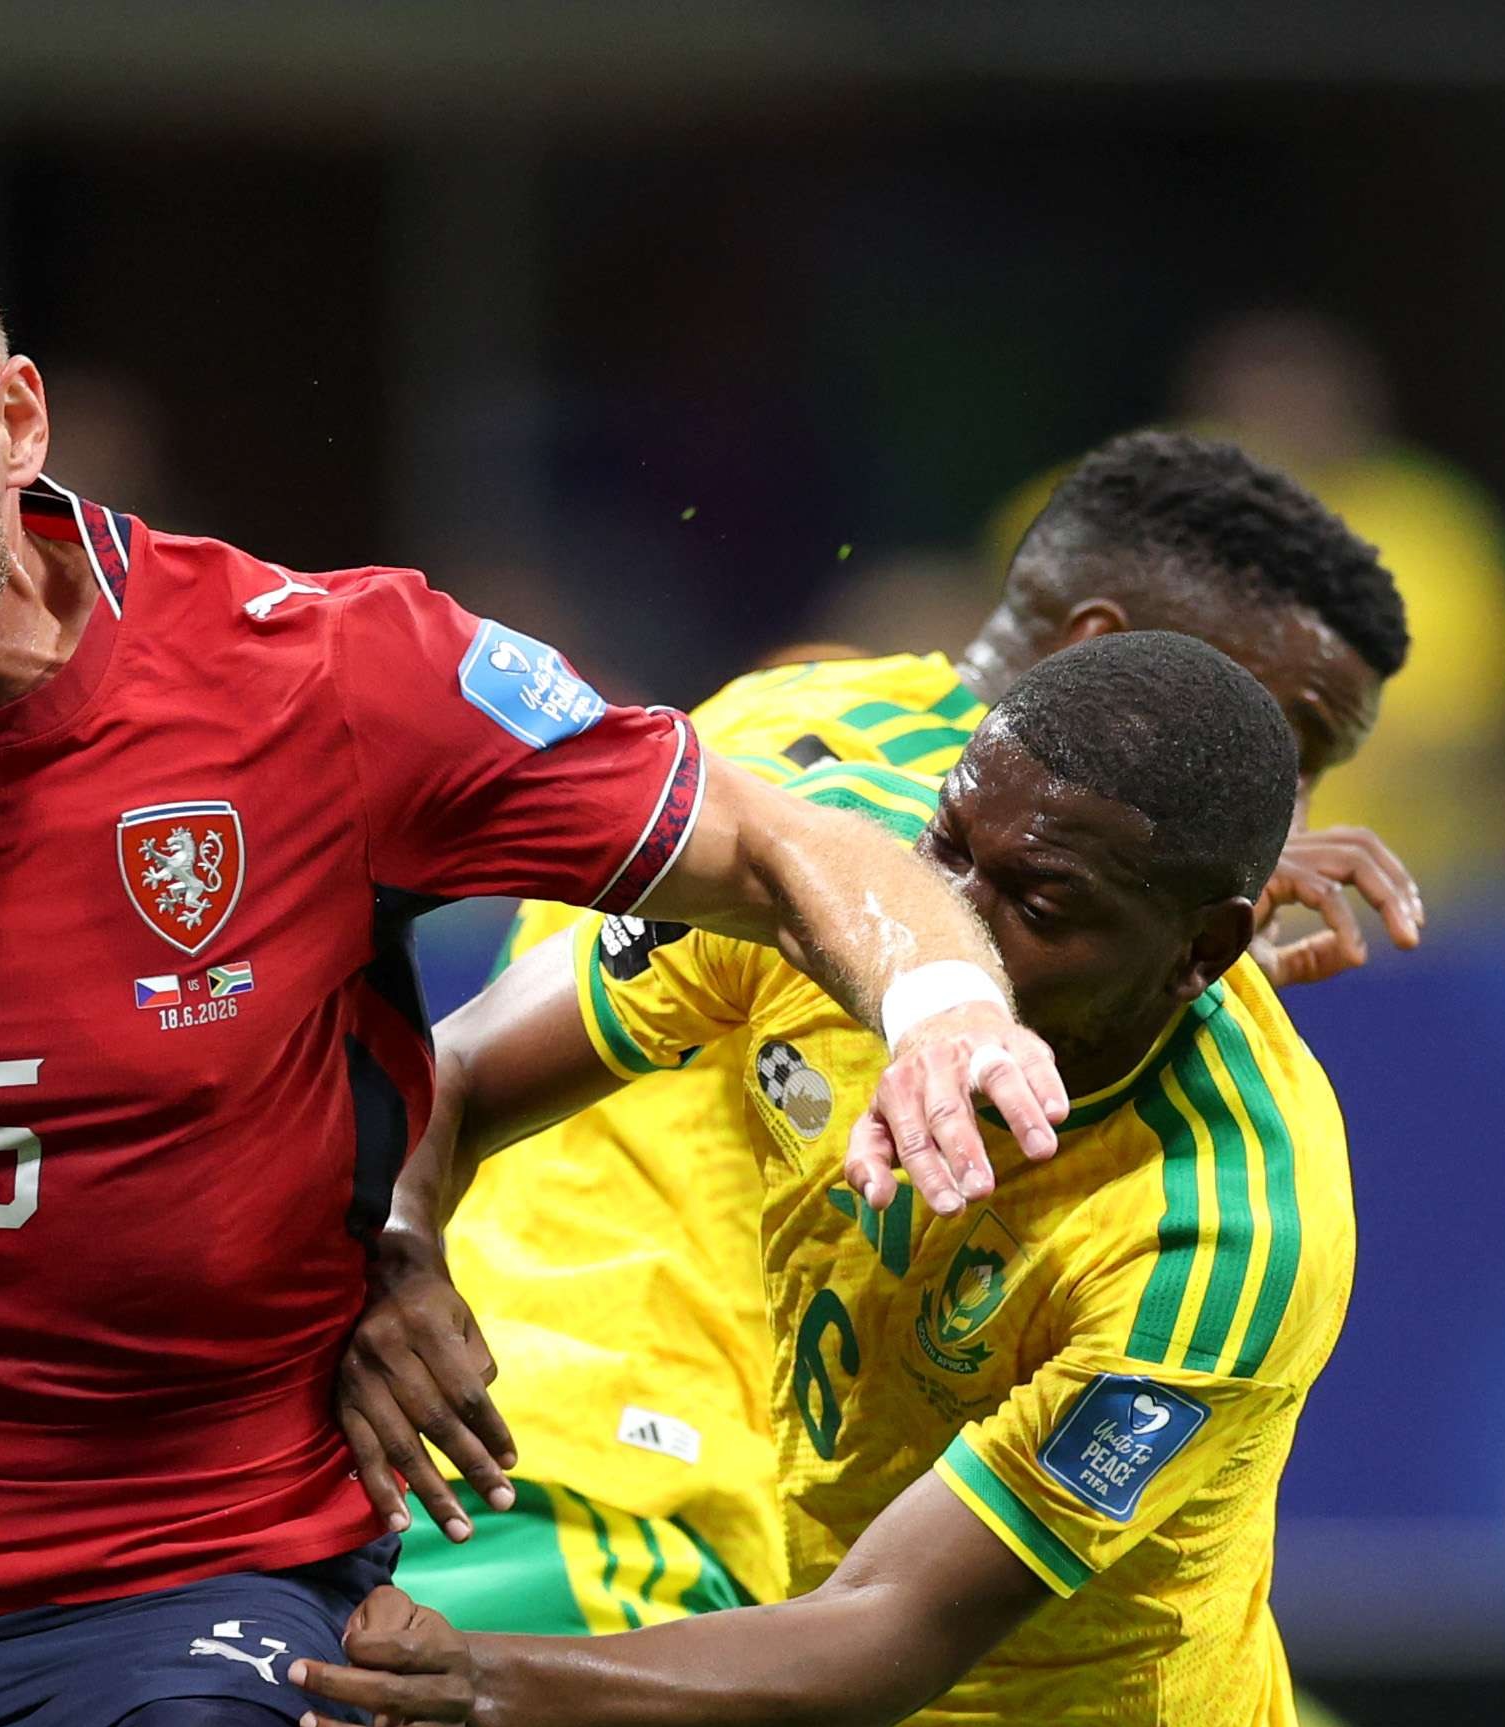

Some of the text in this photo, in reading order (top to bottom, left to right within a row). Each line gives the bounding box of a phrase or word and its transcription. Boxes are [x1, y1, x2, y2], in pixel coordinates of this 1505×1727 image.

[158, 997, 238, 1031] 18.6.2026
[793, 1288, 861, 1461] 6
[936, 1355, 973, 1372] AFRICA
[1093, 1418, 1135, 1455] Unite
[1080, 1440, 1137, 1487] PEACE
[1079, 1469, 1111, 1496] FIFA
